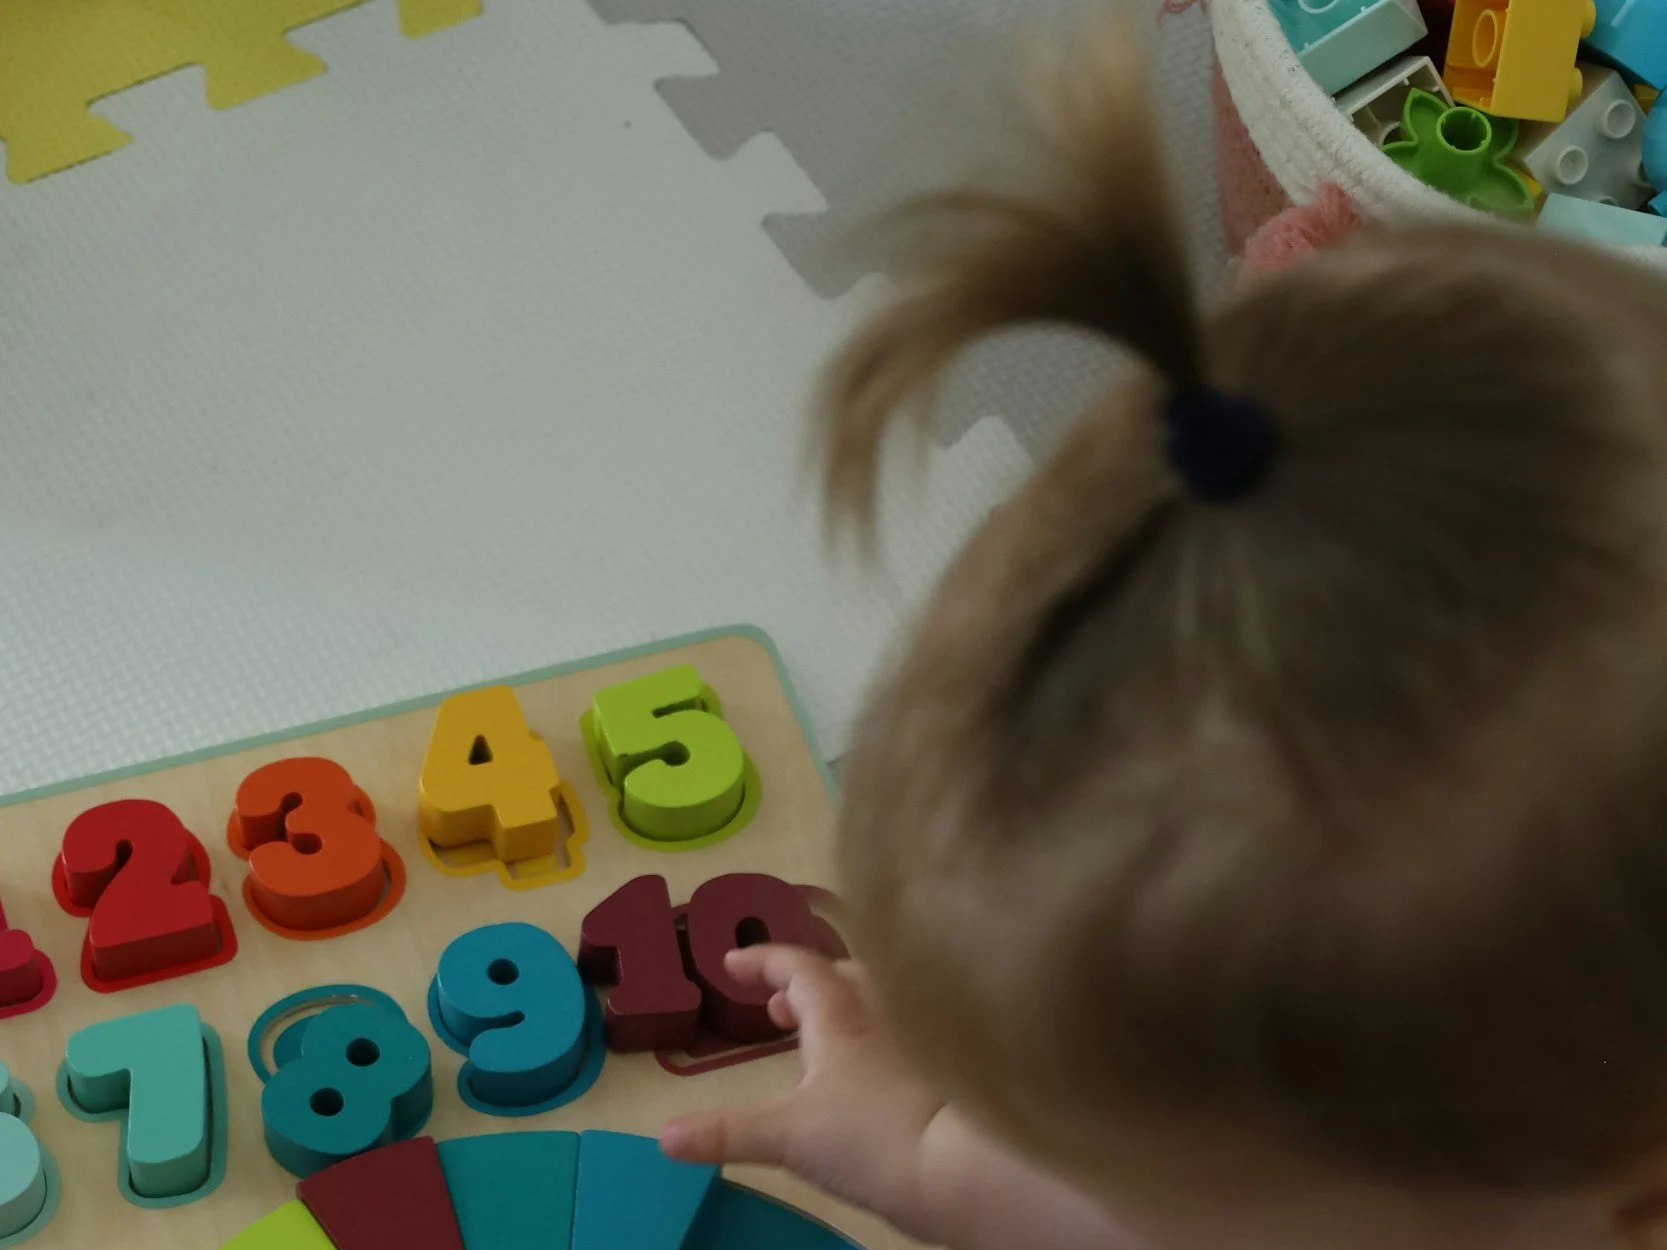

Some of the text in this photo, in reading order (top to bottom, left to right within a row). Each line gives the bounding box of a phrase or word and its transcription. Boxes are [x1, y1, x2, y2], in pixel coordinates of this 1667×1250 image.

[60, 799, 222, 980] 2
[234, 757, 386, 932] 3
[418, 685, 562, 864] 4
[592, 665, 746, 842] 5
[64, 1004, 210, 1198] 7
[261, 1004, 433, 1178] 8
[436, 922, 588, 1107] 9
[577, 873, 850, 1053] 10
